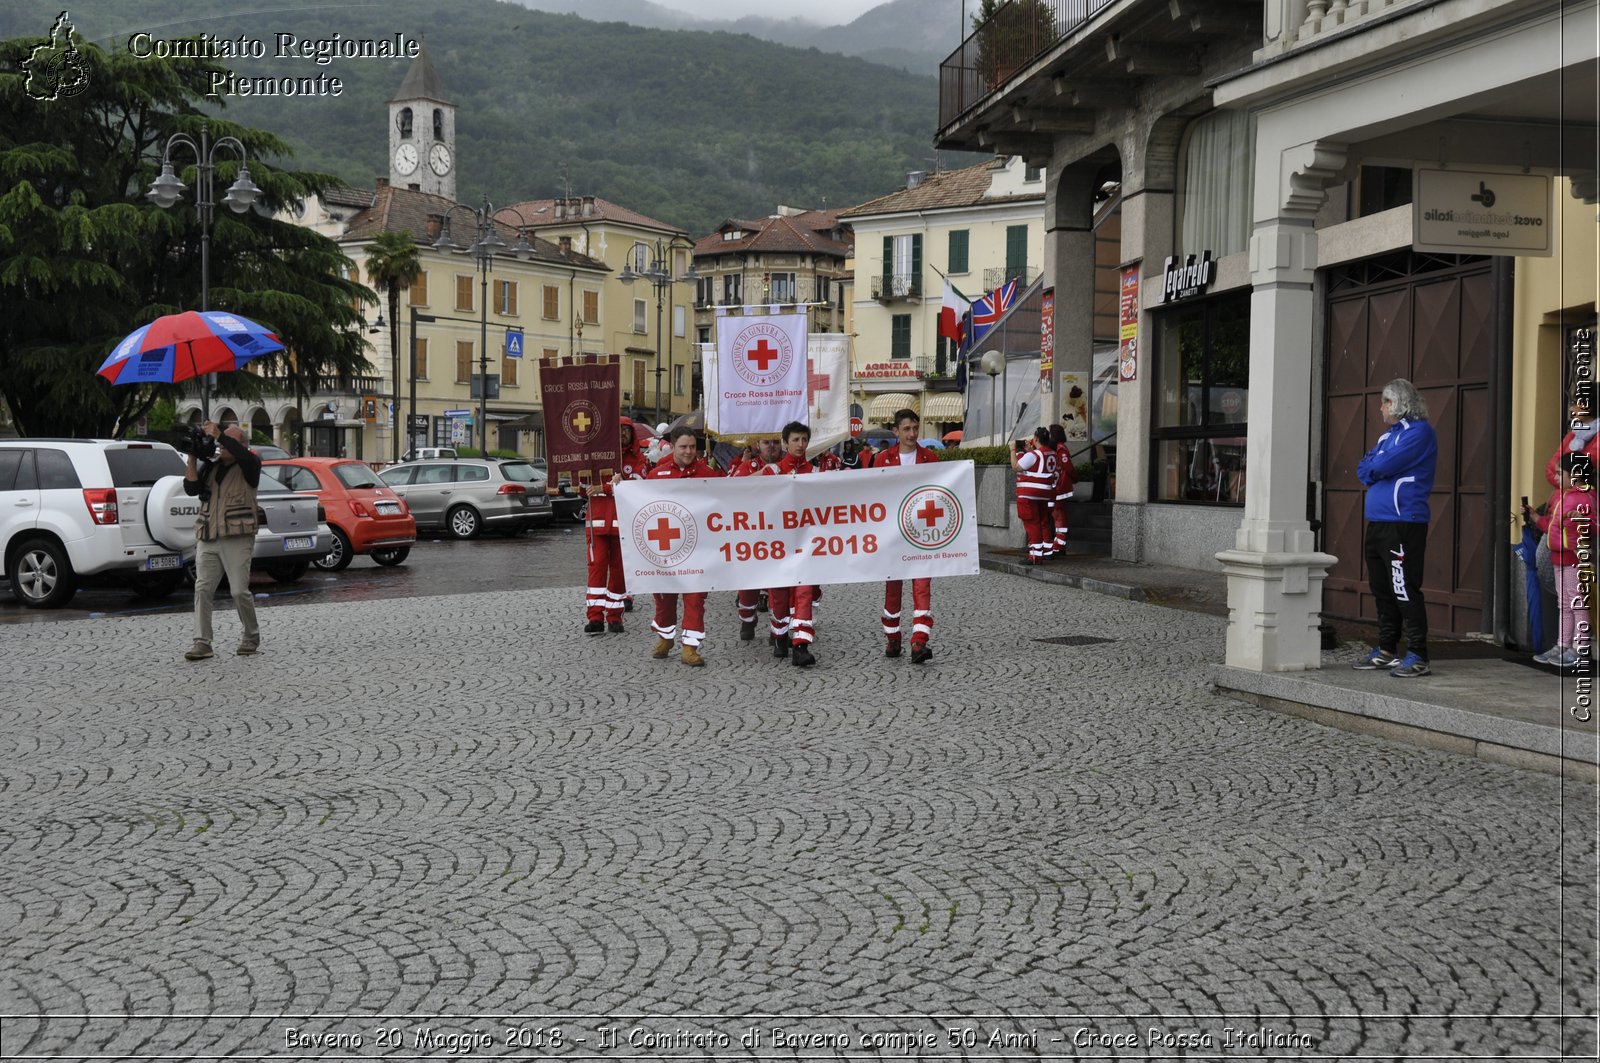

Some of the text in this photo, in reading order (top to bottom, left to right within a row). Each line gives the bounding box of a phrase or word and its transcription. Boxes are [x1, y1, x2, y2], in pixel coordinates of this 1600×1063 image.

[1180, 287, 1198, 298] ZANETTI
[748, 325, 779, 337] GINEVRA
[780, 344, 791, 374] AGOSTO
[865, 362, 910, 370] AGENZIA
[544, 380, 615, 393] CROCE ROSSA ITALIANA
[724, 389, 802, 399] Croce Rossa Italiana
[735, 399, 762, 407] Comitato
[851, 423, 863, 432] TOP
[591, 451, 615, 460] MERGOZZO
[170, 506, 200, 516] SUZU
[706, 502, 887, 532] C.R.I. BAVENO
[648, 503, 682, 516] GINEVRA
[683, 523, 695, 554] AGOSTO
[922, 528, 940, 543] 50
[719, 540, 786, 562] 1968
[811, 533, 878, 556] 2018
[902, 554, 933, 562] Comitato
[942, 551, 968, 559] Baveno
[677, 568, 704, 576] Italiana
[1390, 559, 1410, 602] LEGEA
